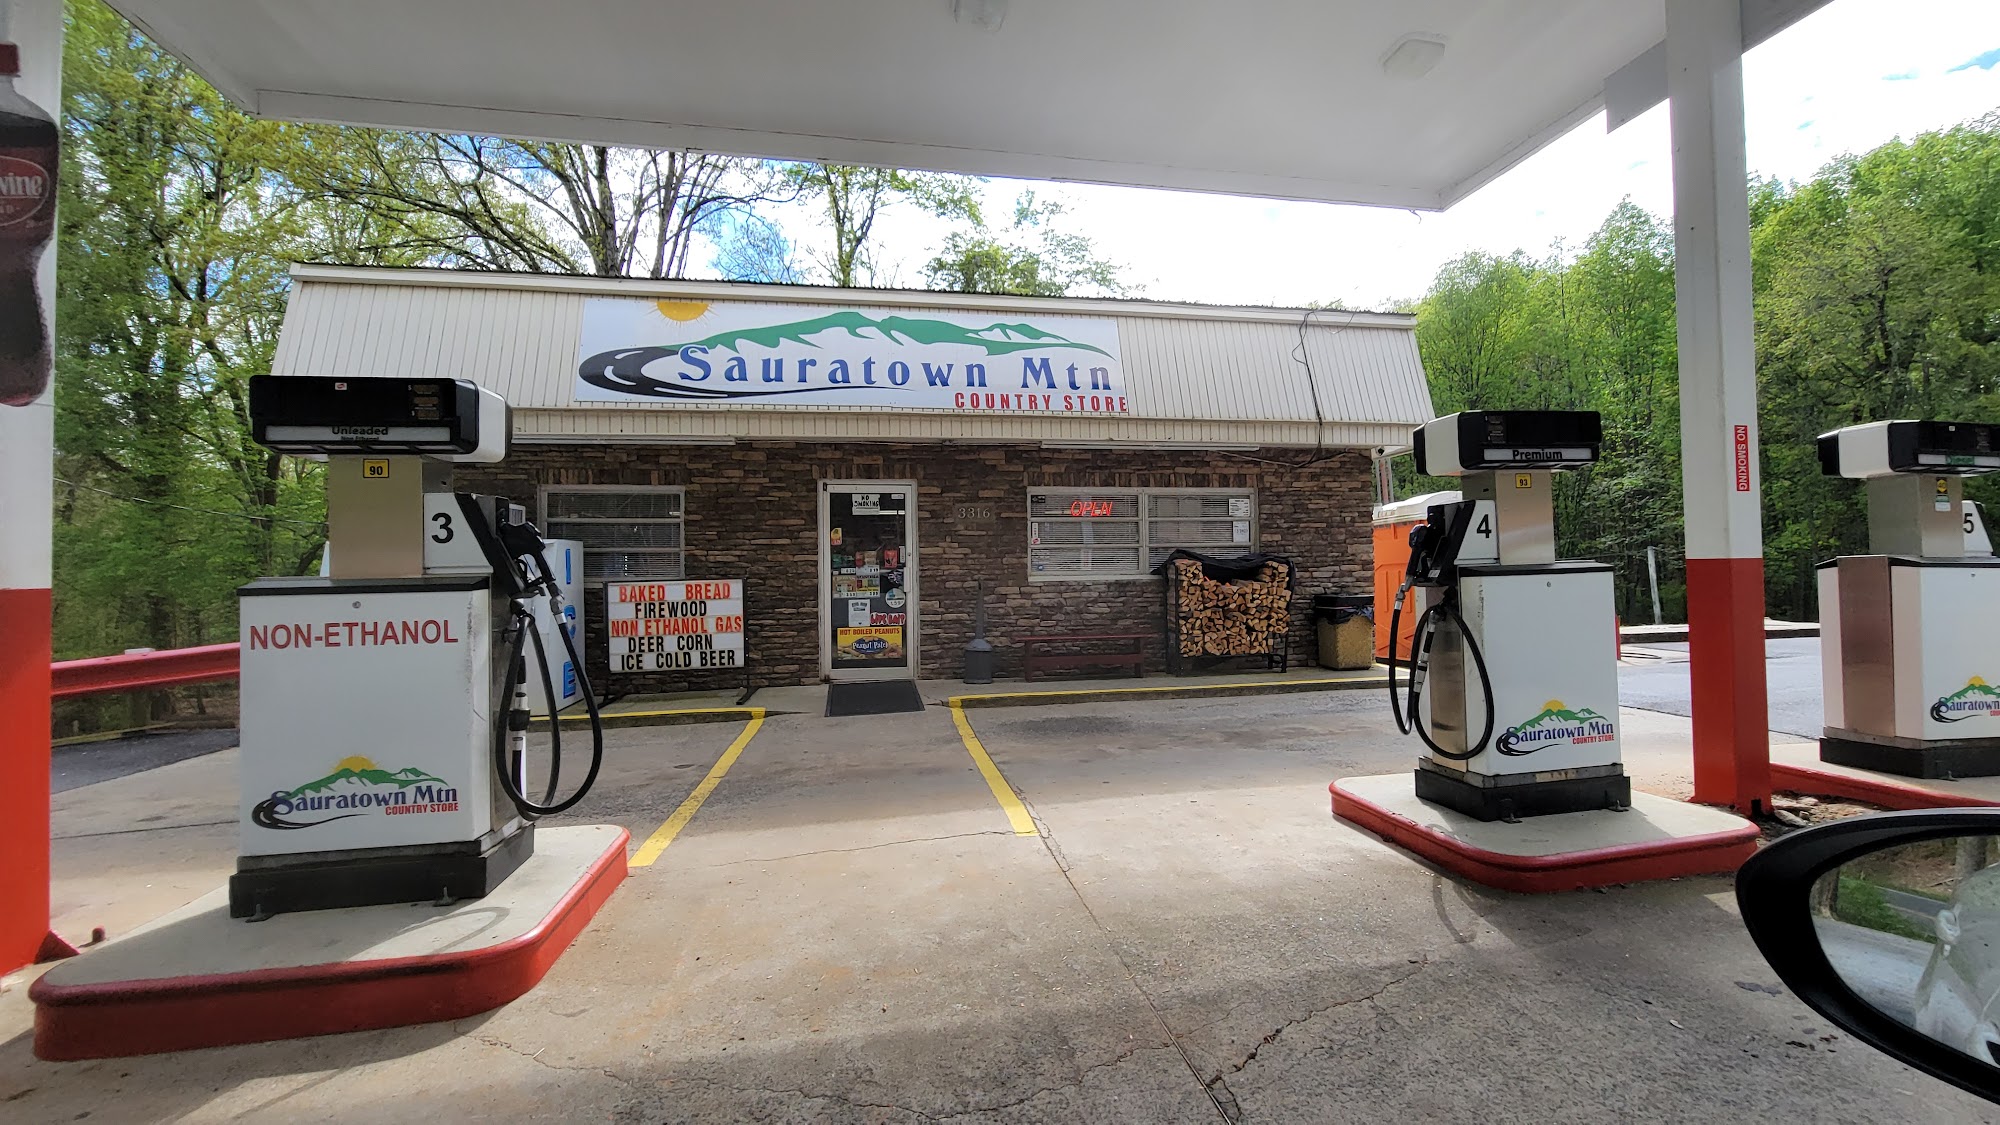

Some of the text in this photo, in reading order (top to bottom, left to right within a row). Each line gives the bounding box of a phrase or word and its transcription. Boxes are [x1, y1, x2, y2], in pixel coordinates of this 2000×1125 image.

[678, 345, 1112, 390] Sauratown Mtn
[954, 392, 1127, 411] COUNTRY STORE
[331, 426, 389, 435] Unleaded
[1512, 449, 1563, 460] Premium
[1737, 426, 1749, 490] NO SMOKING
[369, 466, 383, 475] 90
[958, 507, 990, 519] 3316
[1070, 501, 1113, 516] OPEN
[431, 512, 454, 544] 3
[1476, 514, 1492, 539] 4
[1963, 513, 1974, 534] 5
[619, 583, 731, 602] BAKED BREAD
[634, 601, 707, 619] FIREWOOD
[250, 619, 459, 650] NON-ETHANOL
[611, 616, 742, 637] NON ETHANOL GAS
[628, 634, 713, 653] DEER CORN
[621, 650, 735, 670] ICE COLD BEER
[1938, 696, 2000, 713] Sauratown
[1506, 721, 1613, 746] Sauratown Mtn
[1572, 734, 1615, 745] COUNTRY STORE
[271, 785, 458, 815] Sauratown Mtn
[385, 803, 459, 815] COUNTRY STORE
